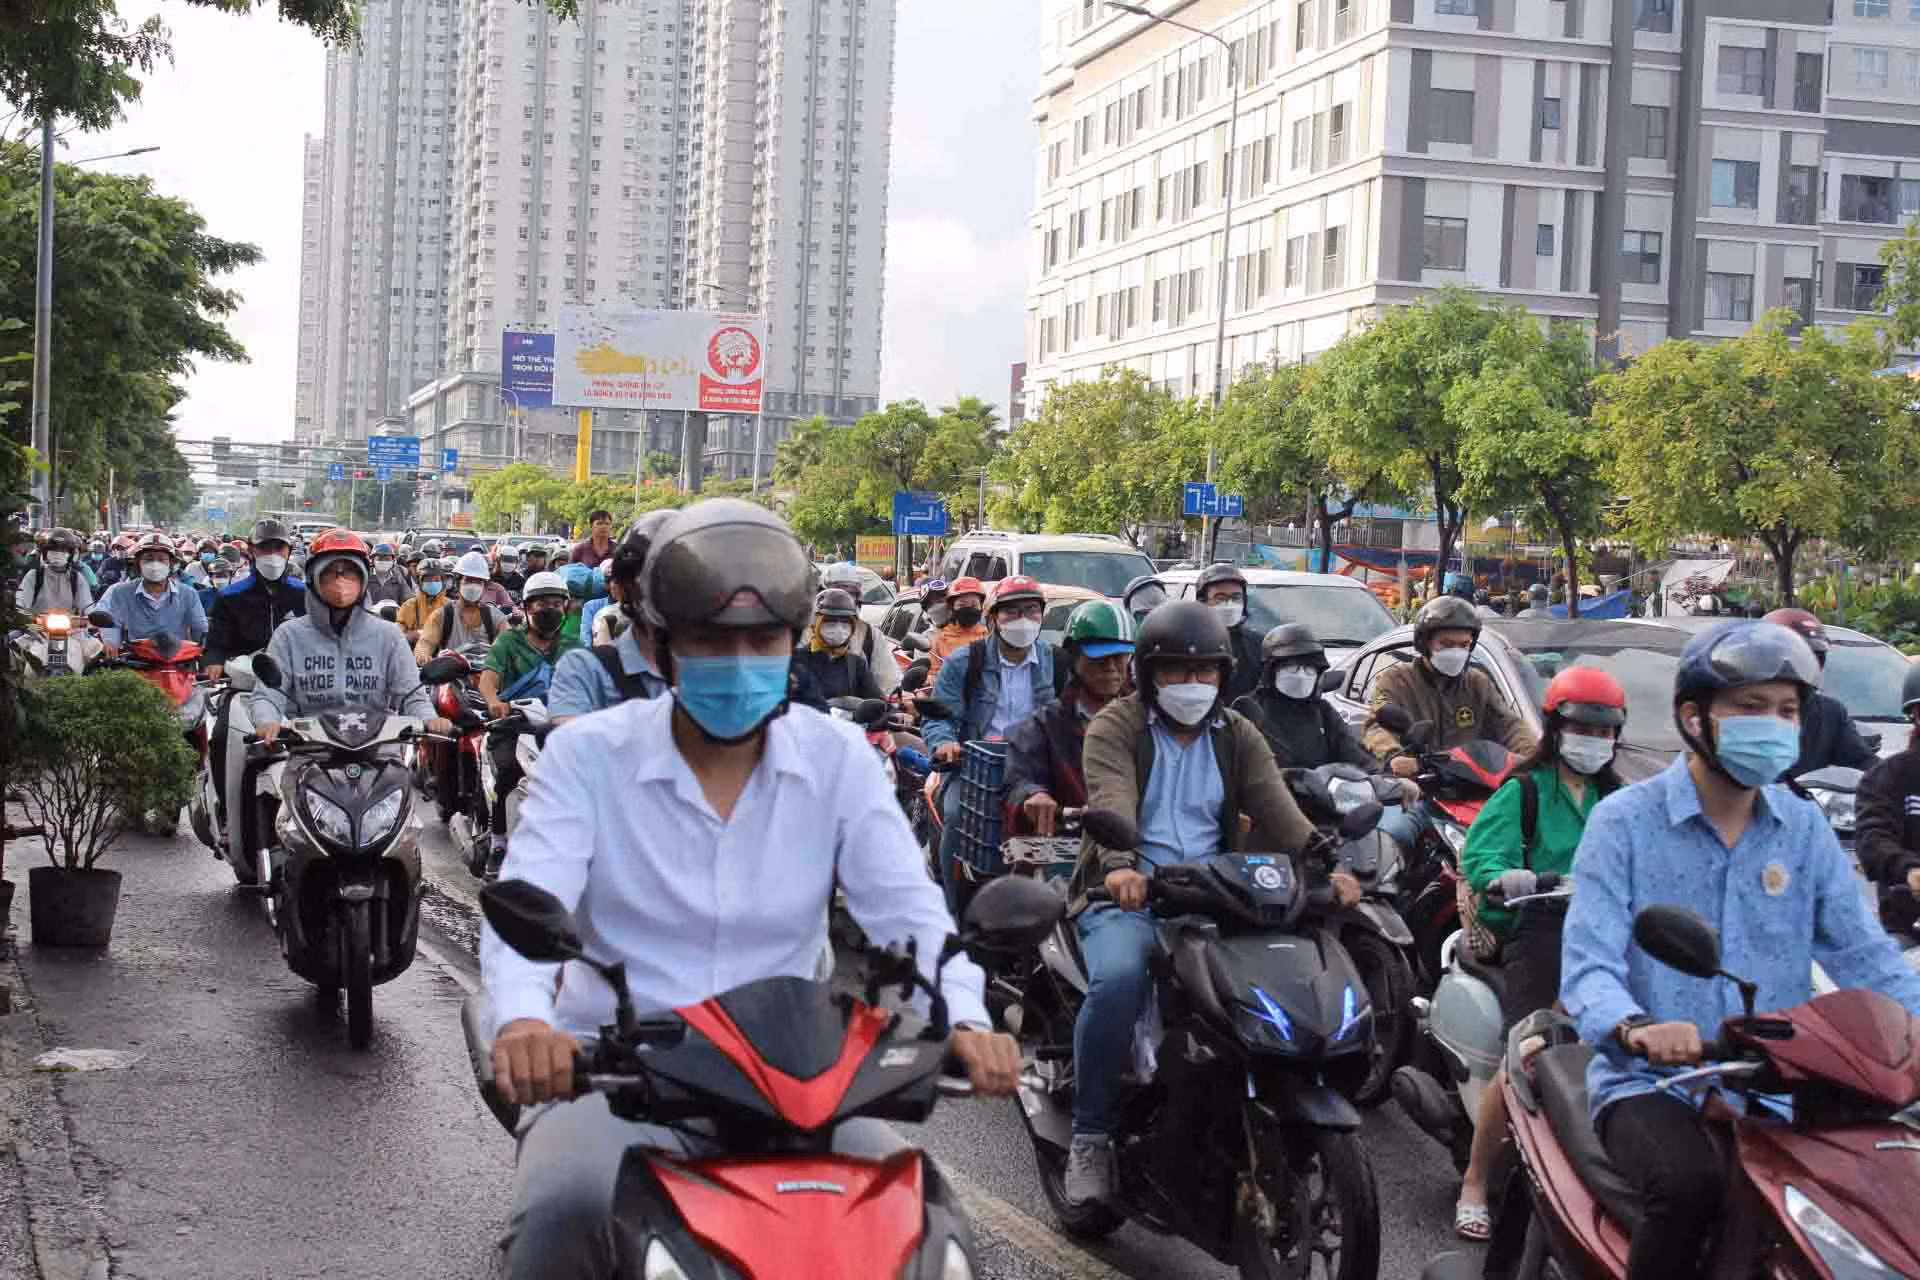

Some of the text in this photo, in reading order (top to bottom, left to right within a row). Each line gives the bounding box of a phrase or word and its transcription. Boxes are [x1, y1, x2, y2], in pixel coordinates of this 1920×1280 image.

[304, 655, 372, 671] CHIC AGO
[299, 674, 378, 690] HYDE PARK
